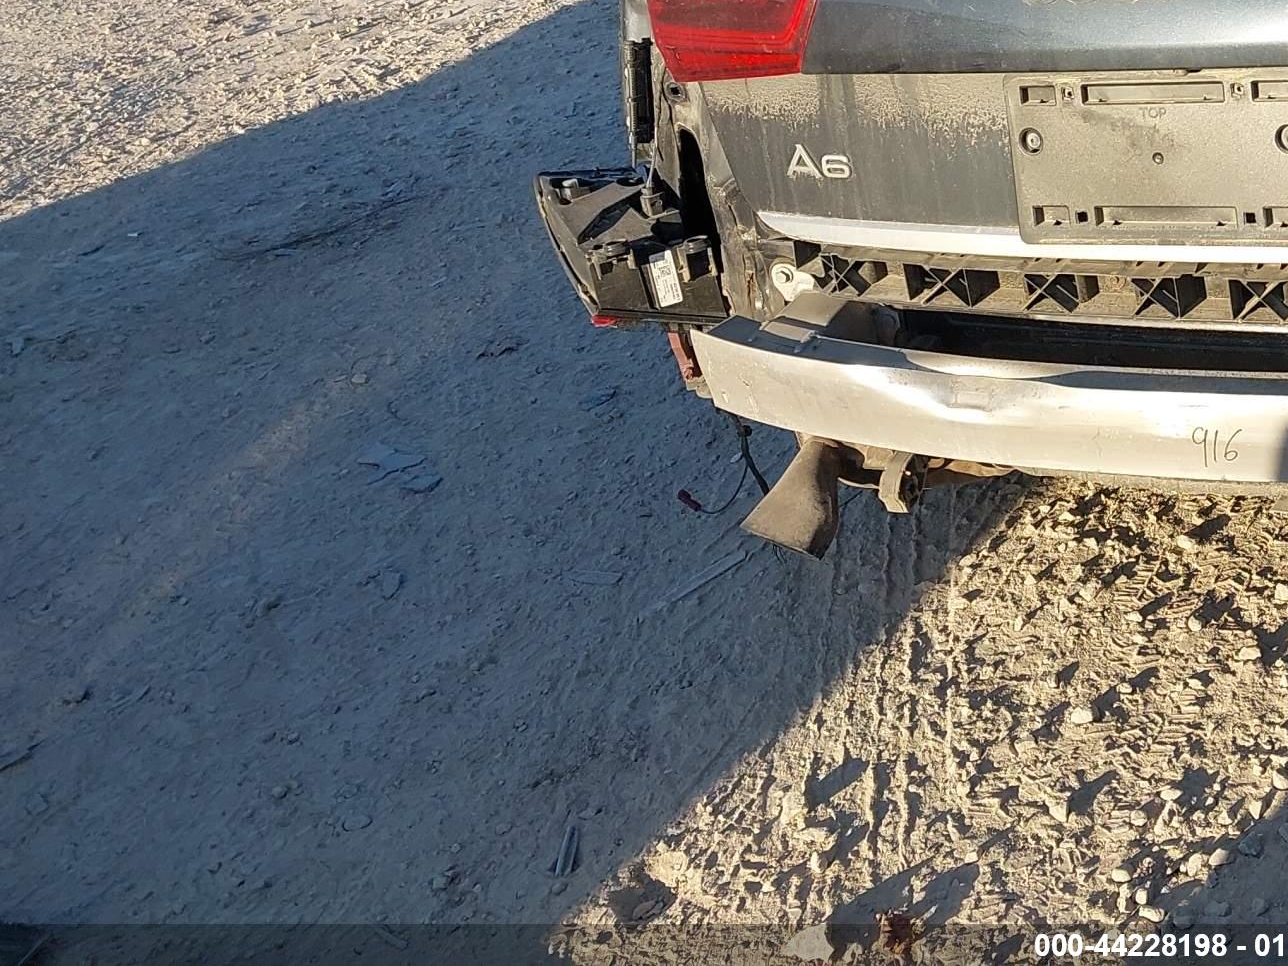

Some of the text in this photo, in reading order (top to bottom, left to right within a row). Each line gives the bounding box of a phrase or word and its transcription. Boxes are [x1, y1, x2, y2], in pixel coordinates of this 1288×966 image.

[1138, 106, 1167, 120] TOP
[786, 143, 851, 179] A6
[1191, 426, 1243, 468] 916
